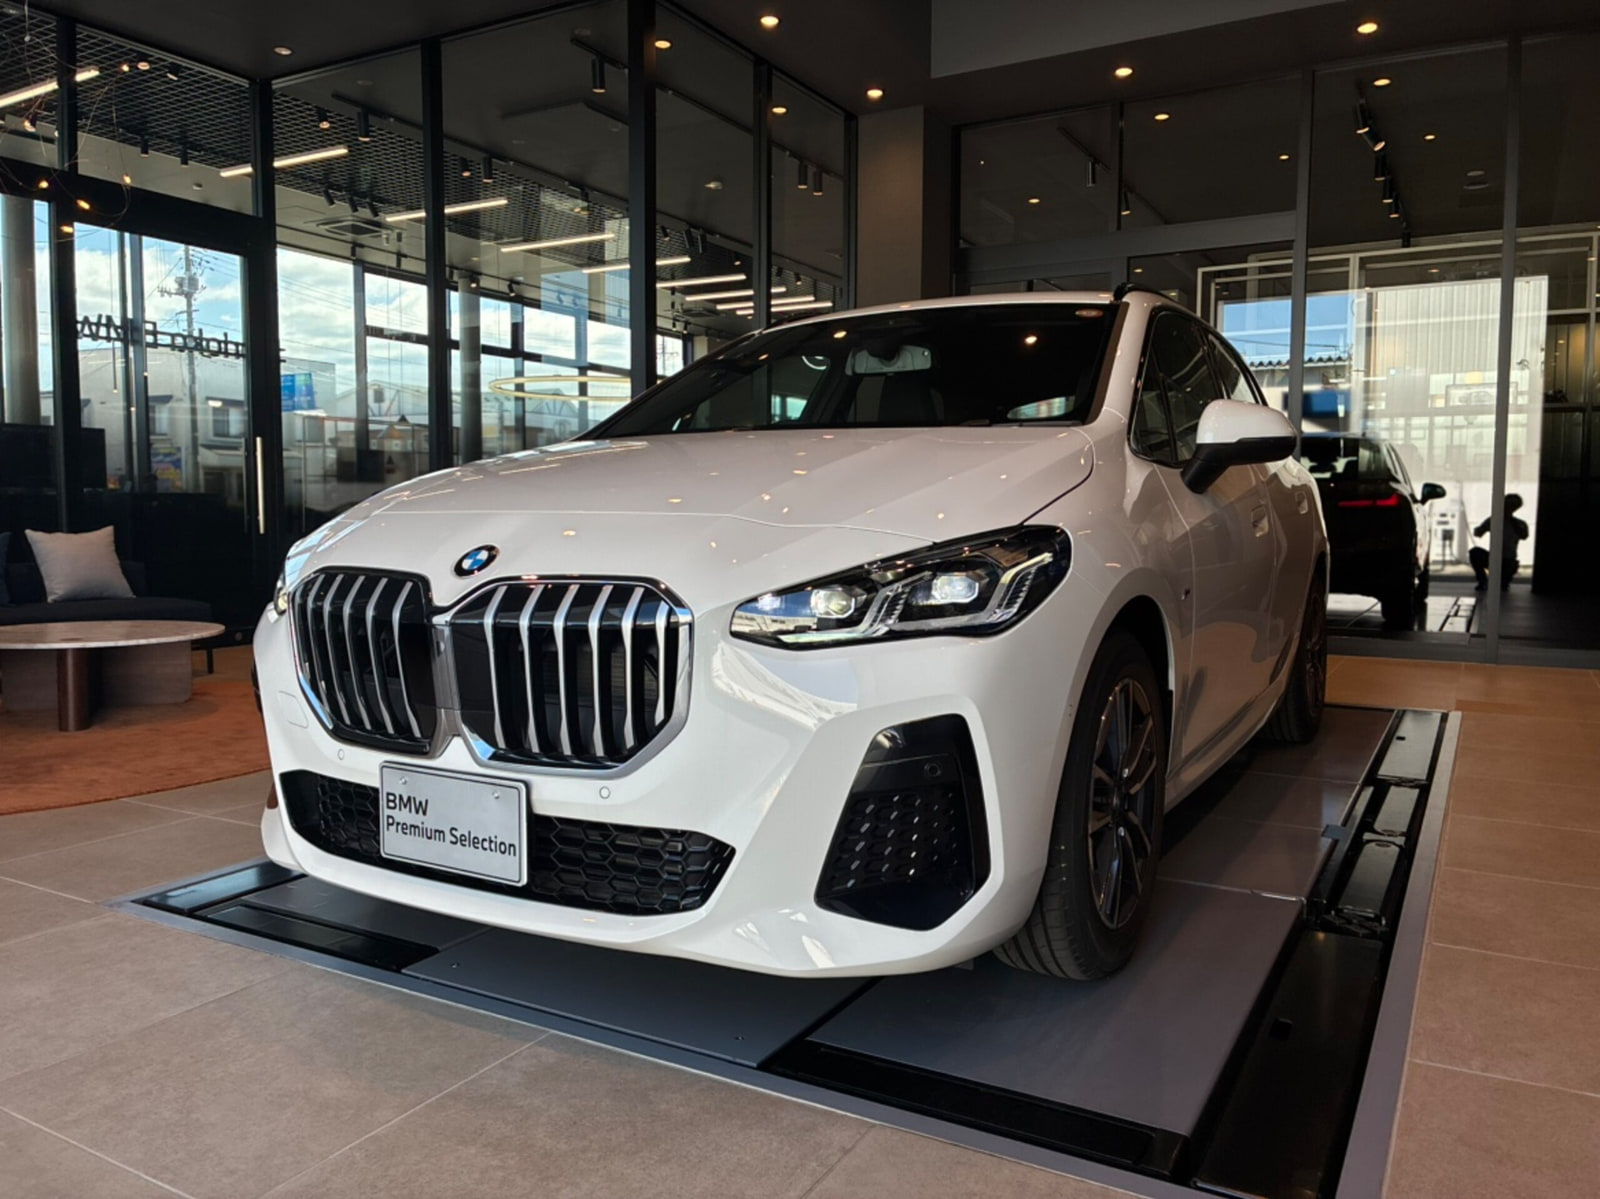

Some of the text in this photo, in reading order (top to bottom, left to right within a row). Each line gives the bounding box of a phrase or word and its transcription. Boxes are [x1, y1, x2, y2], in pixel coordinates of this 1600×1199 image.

[385, 792, 429, 816] BMW
[386, 815, 517, 857] Premium Selection
